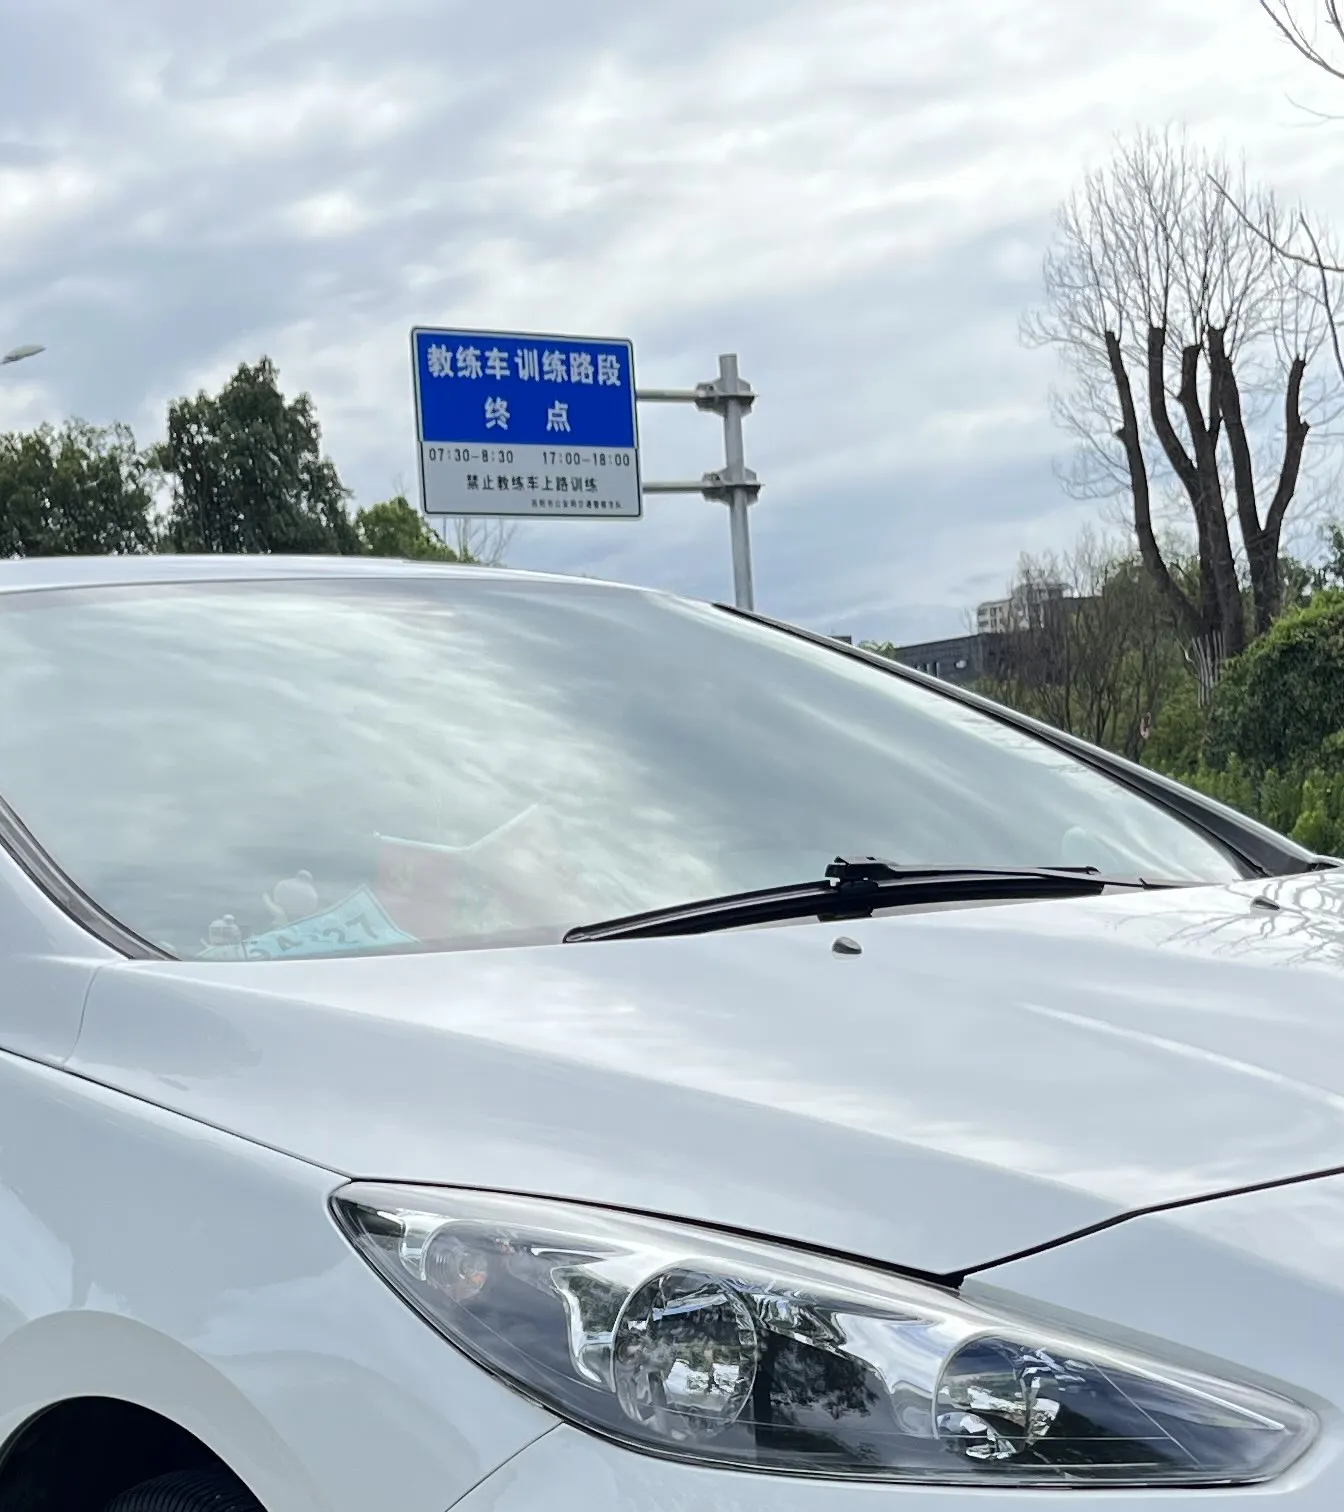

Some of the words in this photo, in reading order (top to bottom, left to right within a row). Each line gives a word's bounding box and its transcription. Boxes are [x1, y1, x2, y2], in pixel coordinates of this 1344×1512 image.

[426, 343, 621, 386] 教练车训练路段
[429, 448, 514, 464] 07:30-8:30
[542, 451, 630, 467] 17:00-18:00
[466, 474, 598, 492] 禁止教练车上路训练
